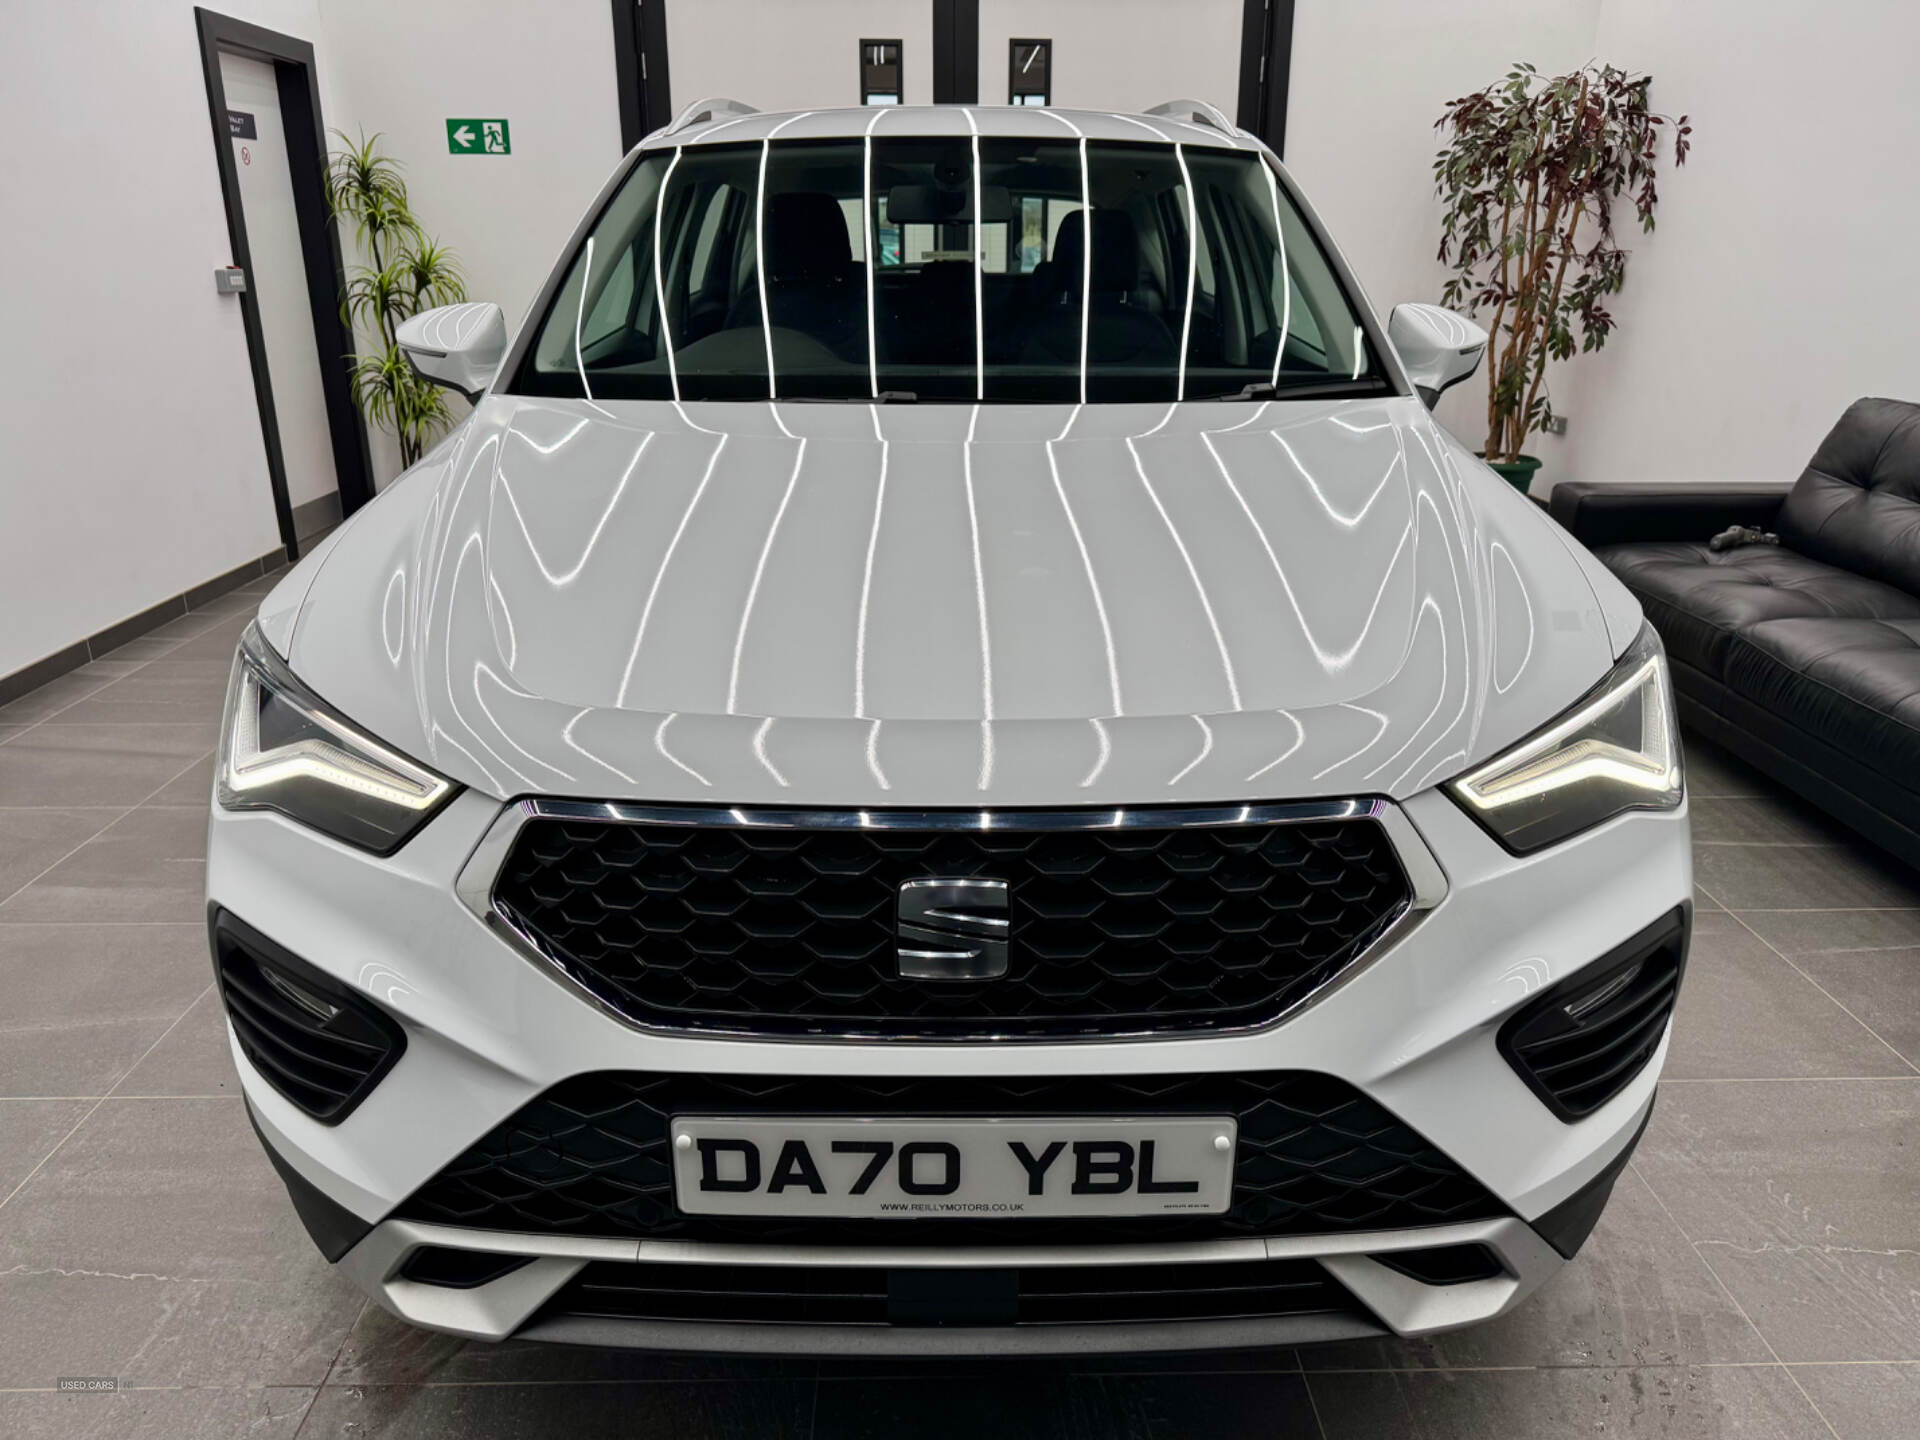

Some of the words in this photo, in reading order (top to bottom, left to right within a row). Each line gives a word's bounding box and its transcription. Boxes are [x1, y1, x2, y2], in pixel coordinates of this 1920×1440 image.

[696, 1138, 960, 1195] DA70
[1007, 1140, 1199, 1195] YBL
[880, 1203, 1024, 1212] WWW.REILLYMOTORS.CO.UK
